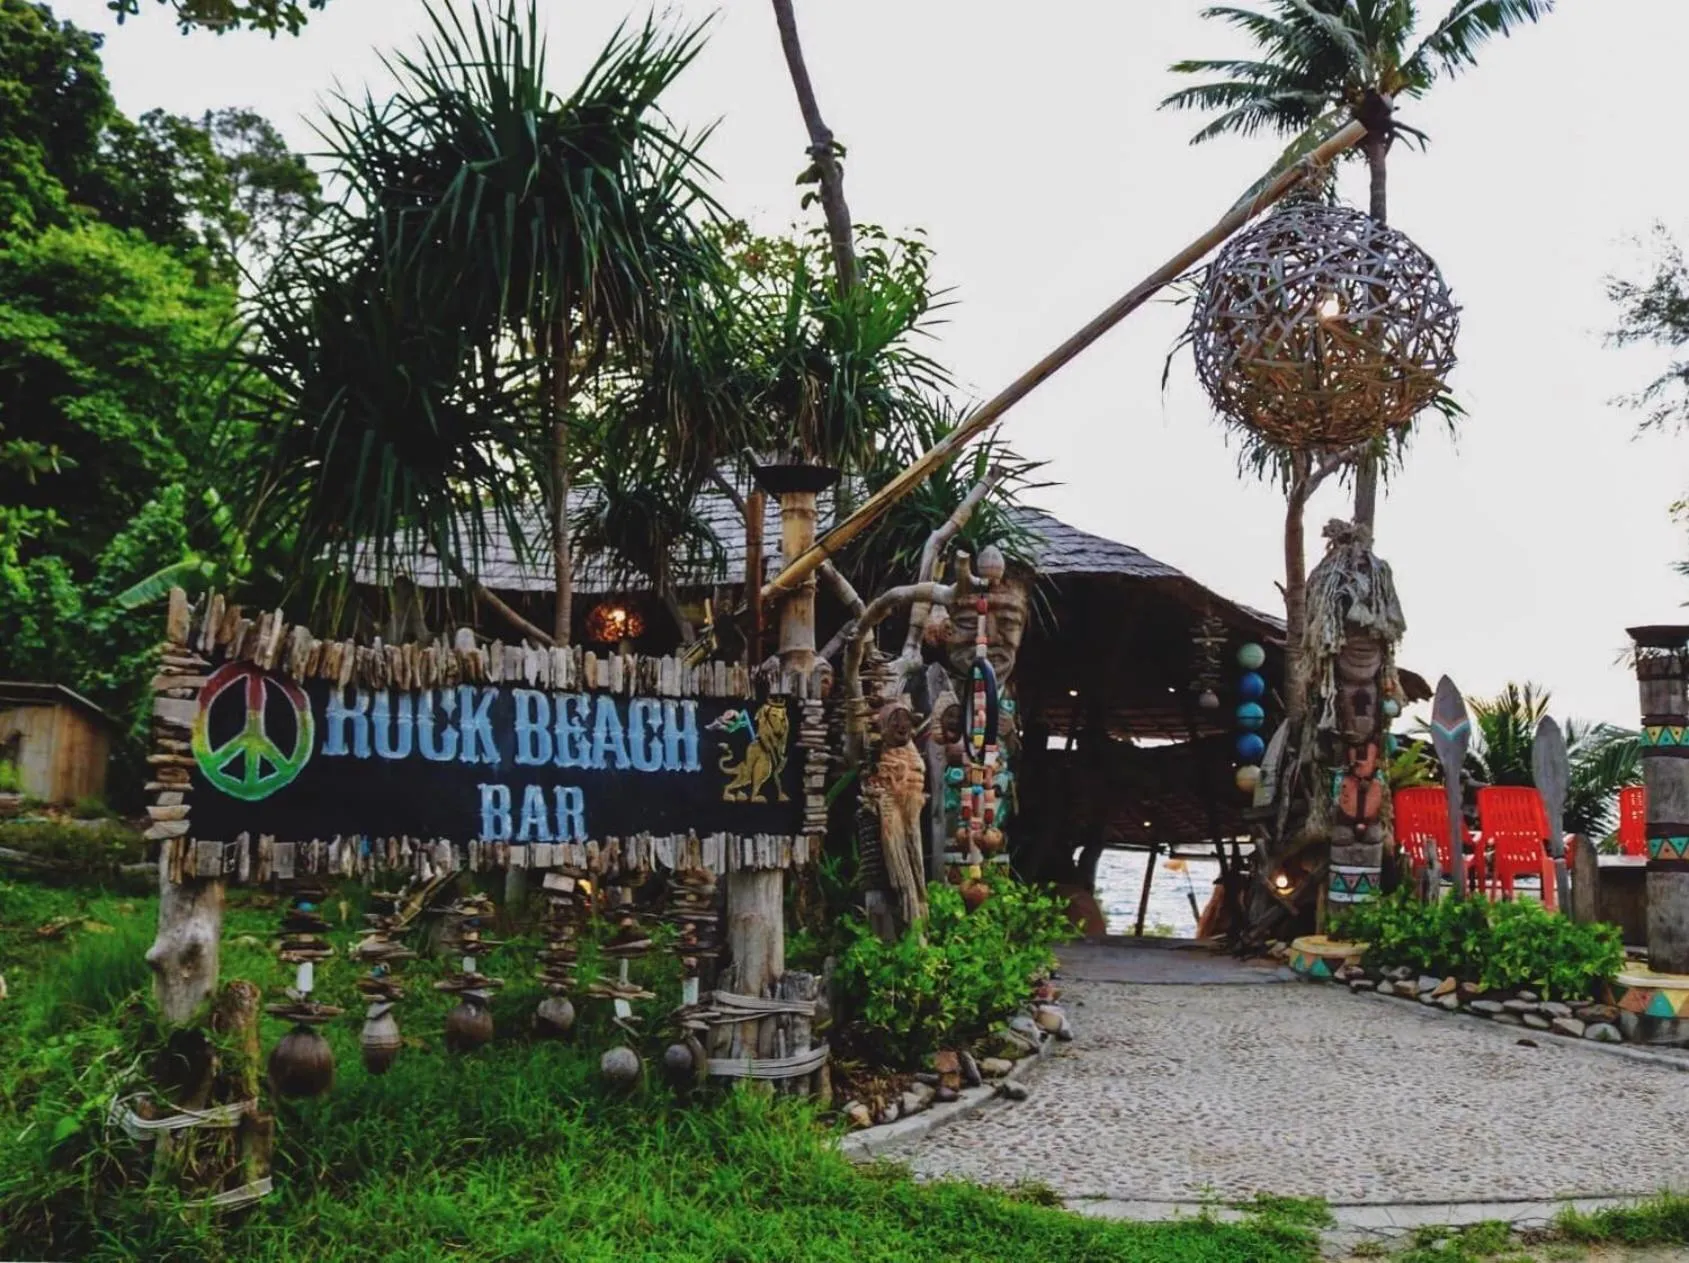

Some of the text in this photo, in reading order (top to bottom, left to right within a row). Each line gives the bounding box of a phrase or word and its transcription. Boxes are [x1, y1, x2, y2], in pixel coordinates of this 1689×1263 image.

[321, 684, 701, 772] ROCK BEACH
[477, 783, 589, 841] BAR
